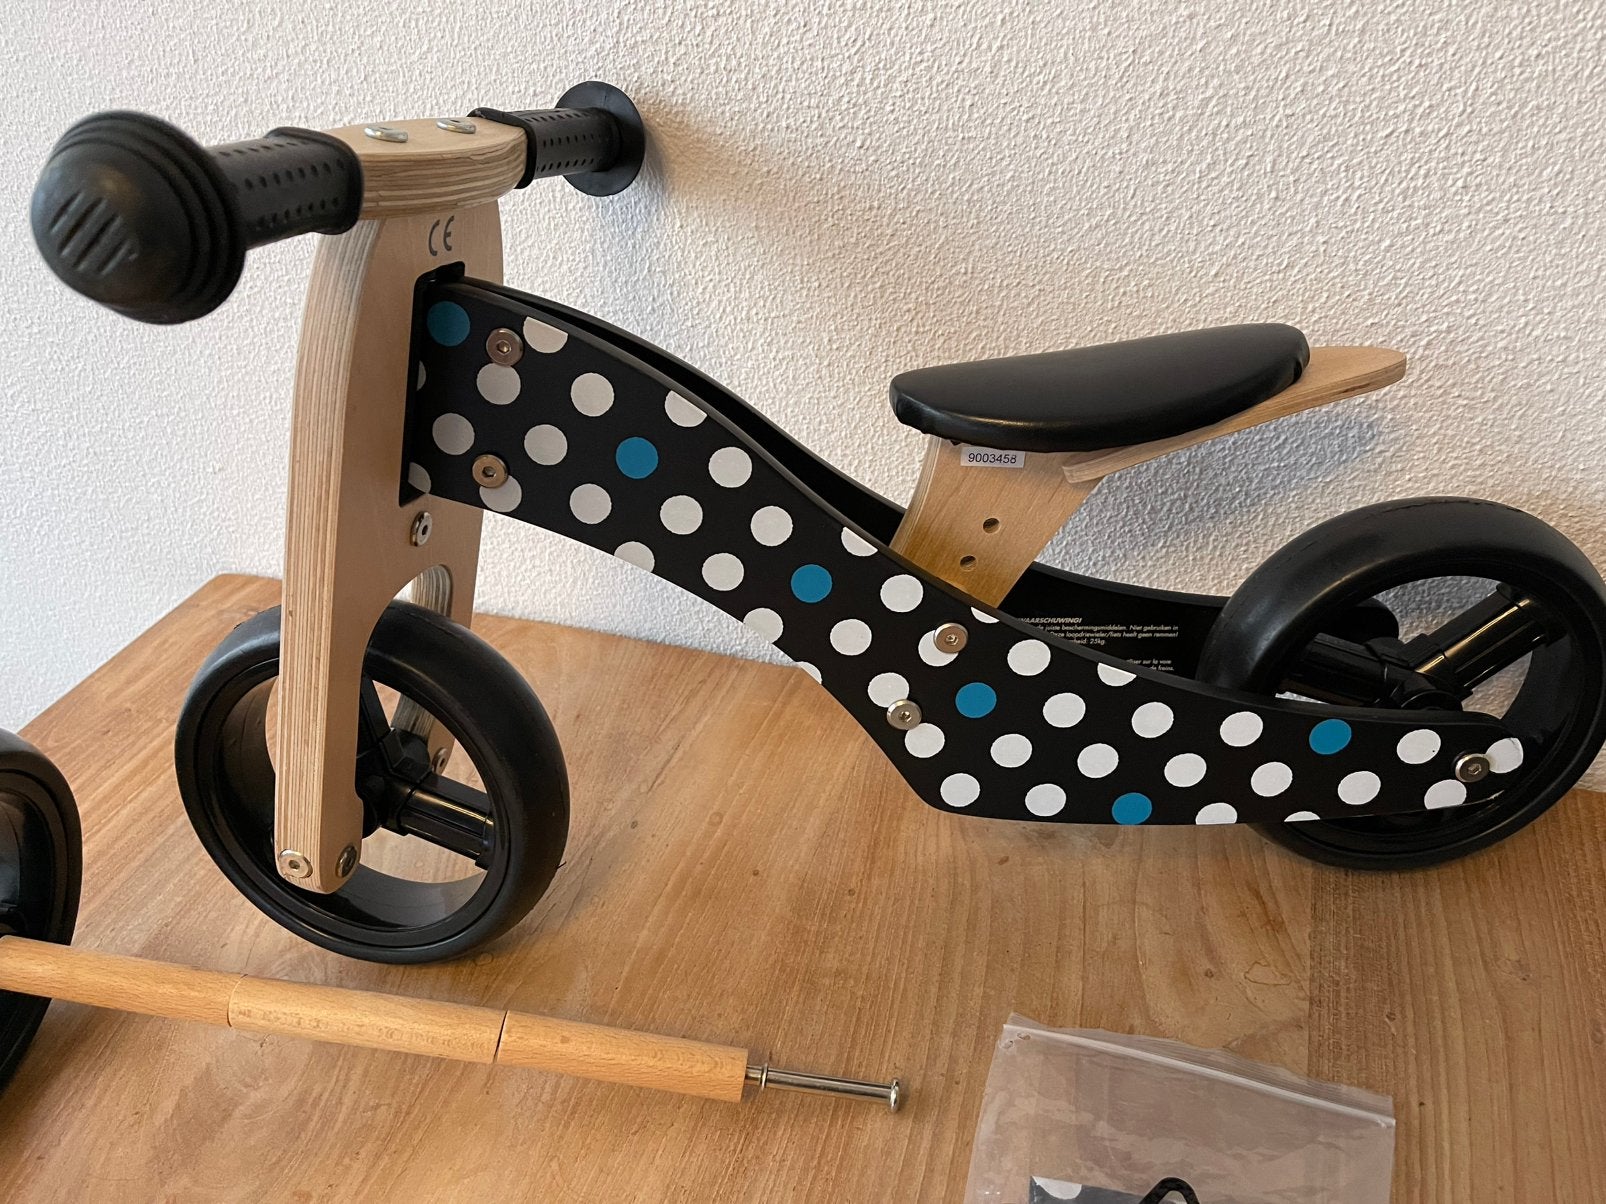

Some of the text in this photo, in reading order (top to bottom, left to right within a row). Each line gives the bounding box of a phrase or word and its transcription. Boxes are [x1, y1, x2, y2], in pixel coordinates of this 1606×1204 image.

[428, 215, 454, 257] CE
[968, 452, 1017, 464] 9003458
[1143, 624, 1171, 632] gebruiken
